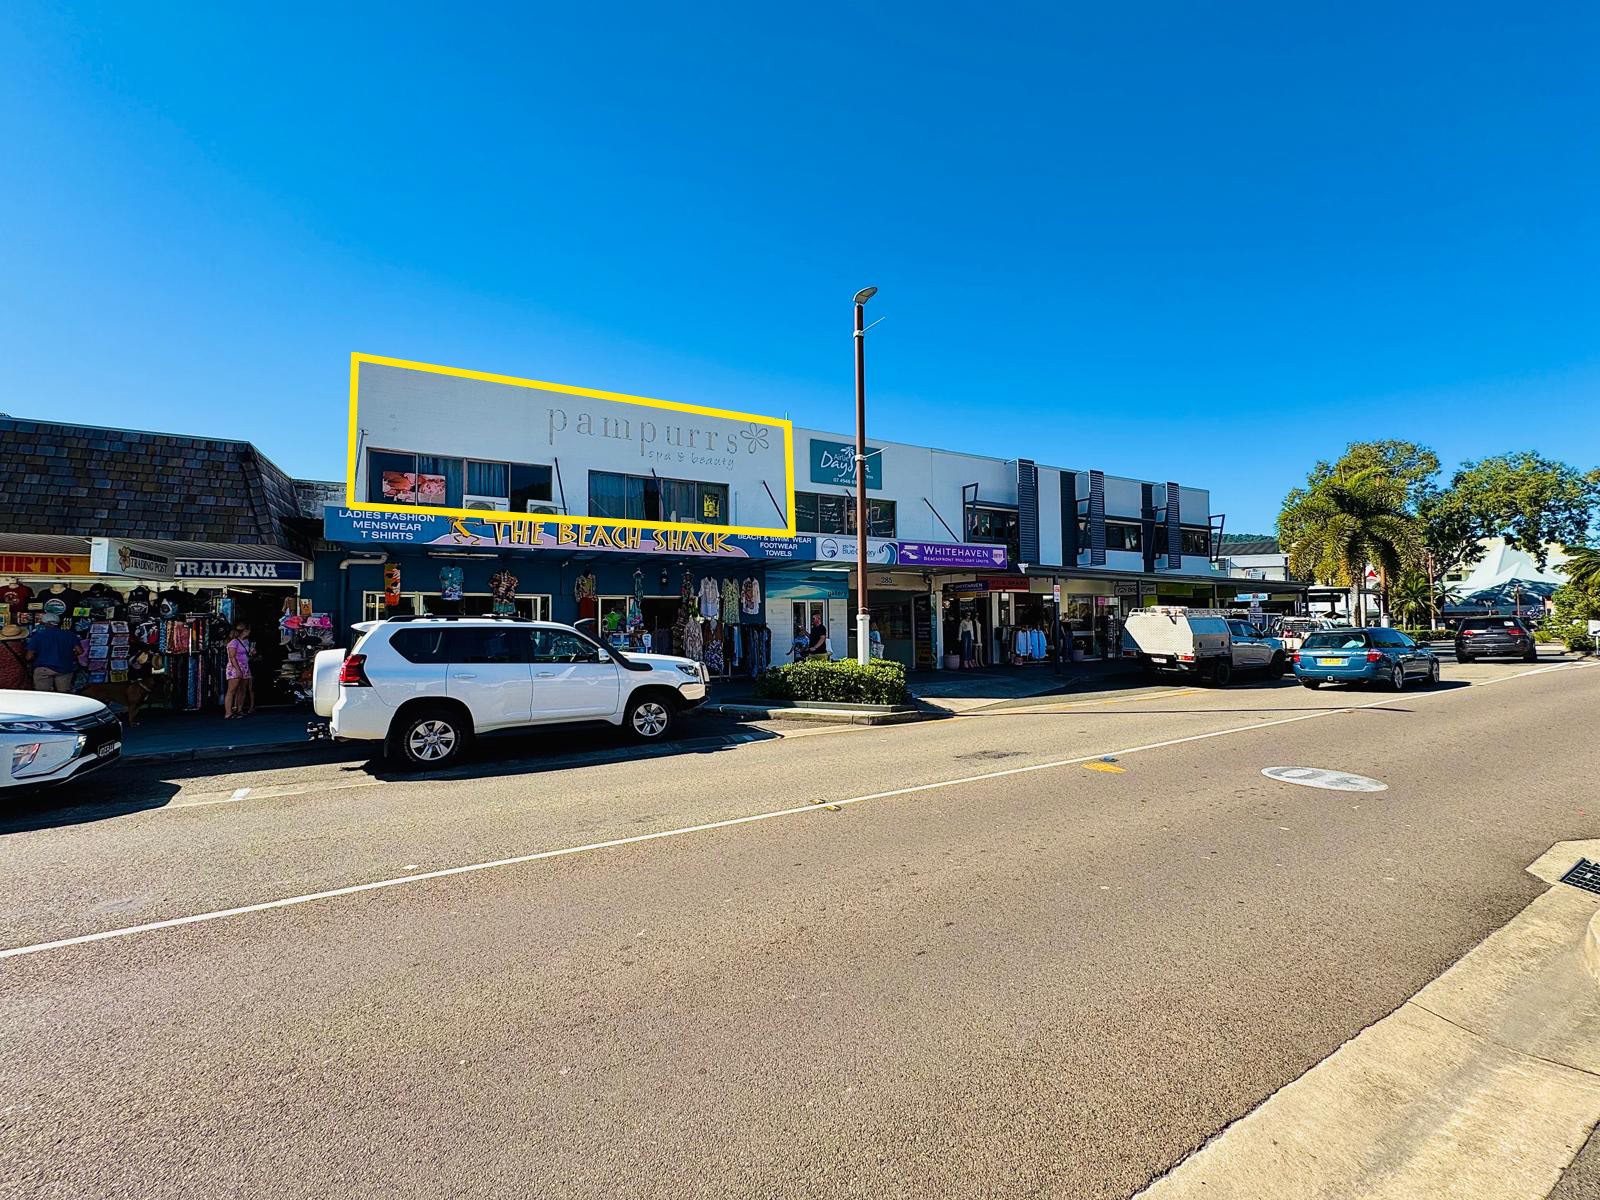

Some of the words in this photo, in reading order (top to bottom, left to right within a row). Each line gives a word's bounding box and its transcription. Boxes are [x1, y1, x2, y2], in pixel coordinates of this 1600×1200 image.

[546, 408, 737, 456] pampurrs
[648, 450, 671, 462] spa
[691, 452, 735, 472] beauty
[338, 509, 381, 519] LADIES
[384, 512, 435, 522] FASHION
[352, 520, 421, 531] MENSWEAR
[371, 531, 414, 540] SHIRTS
[483, 518, 546, 546] THE
[558, 522, 642, 549] BEACH
[652, 529, 735, 553] SHACK
[759, 541, 798, 550] FOOTWEAR
[923, 545, 989, 558] WHITEHAVEN
[130, 557, 154, 571] TRADING
[154, 562, 168, 574] POST
[174, 561, 278, 577] TRALIANA
